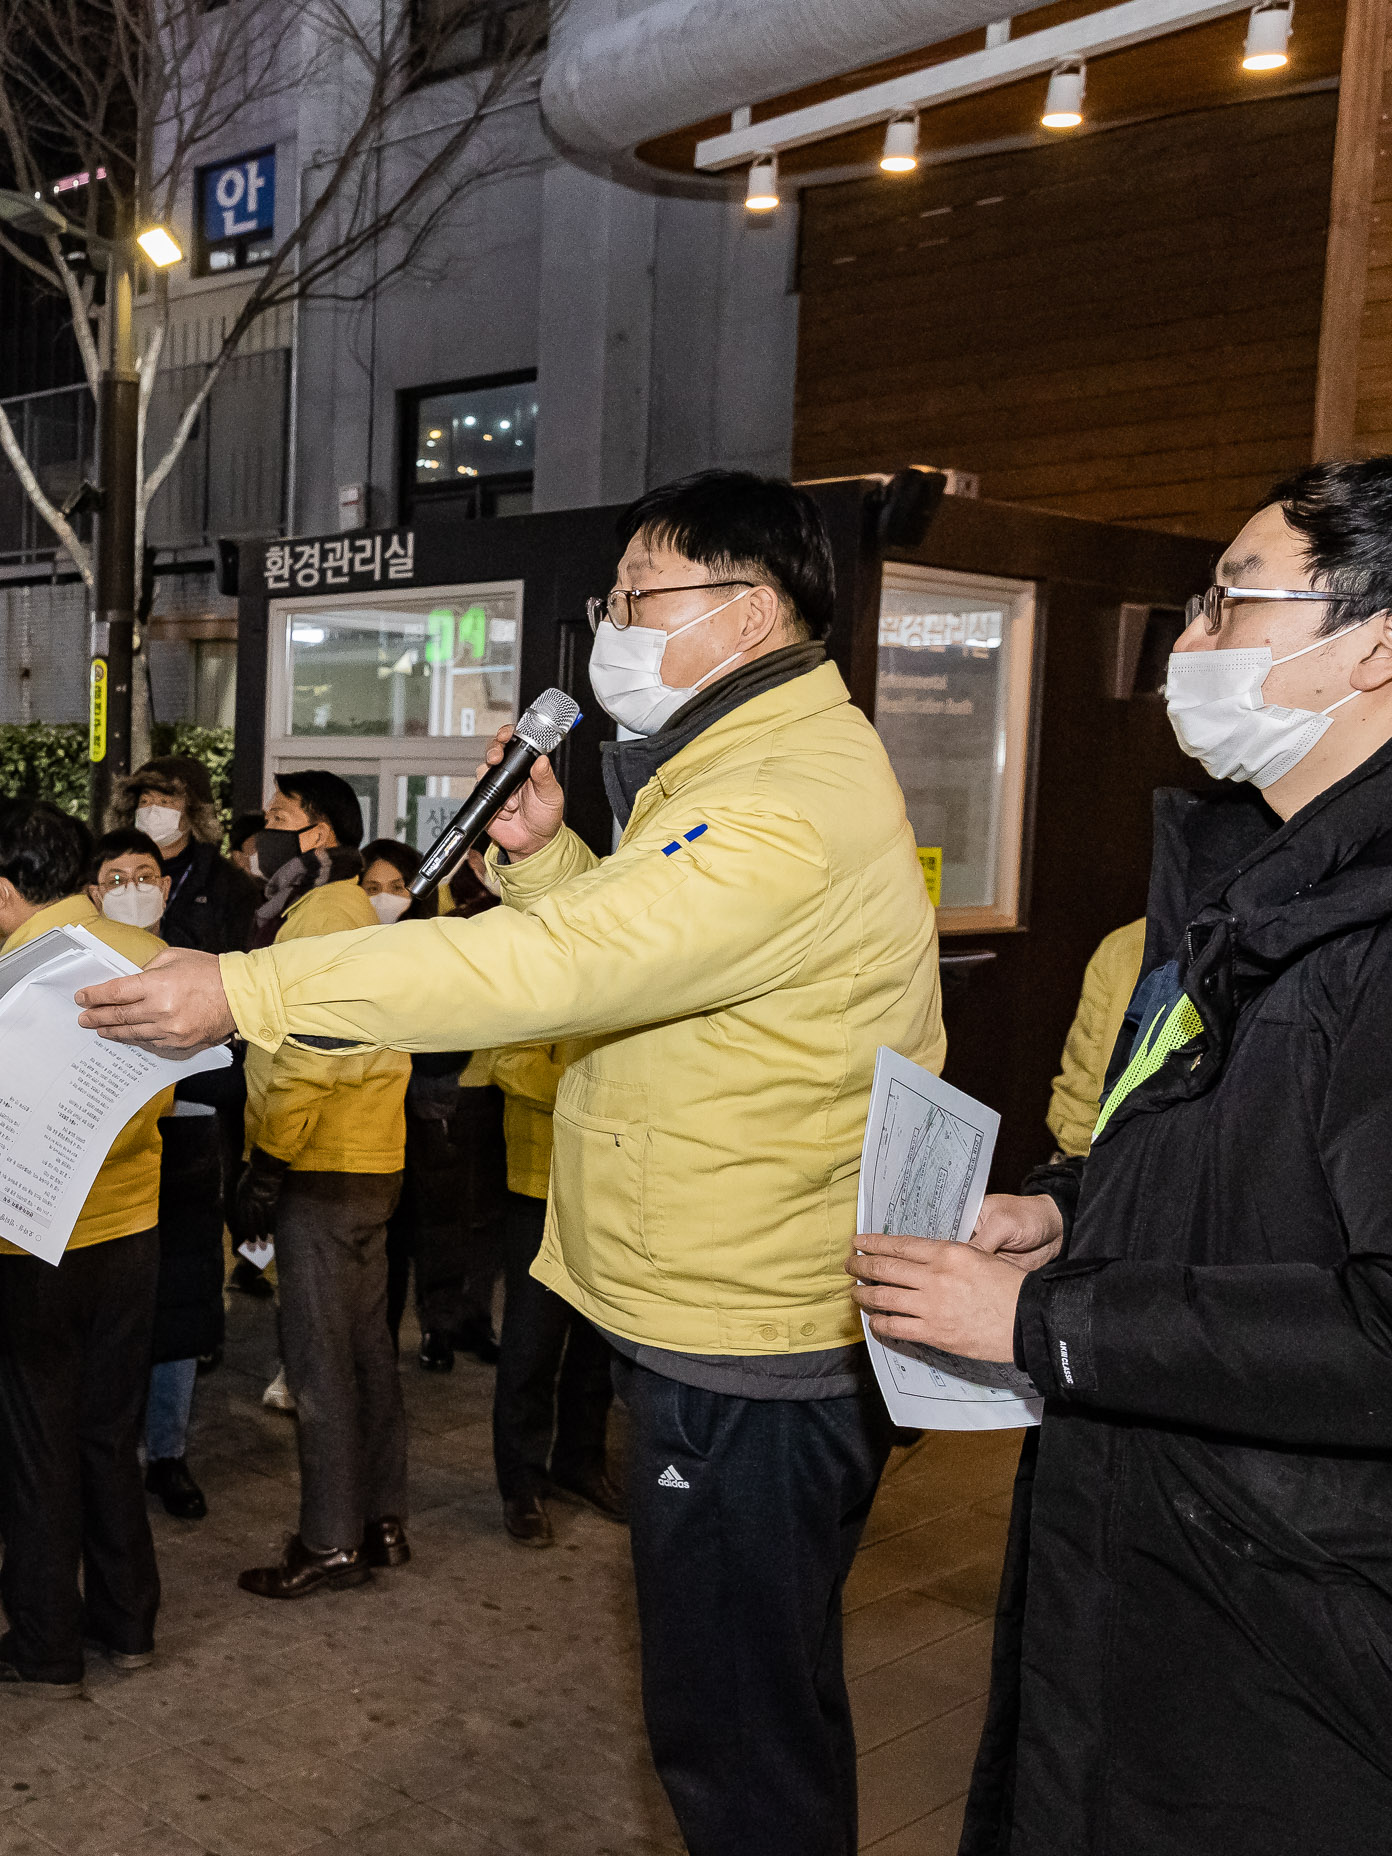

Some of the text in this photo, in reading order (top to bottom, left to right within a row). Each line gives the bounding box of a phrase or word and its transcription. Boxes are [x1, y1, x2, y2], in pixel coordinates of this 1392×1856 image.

[216, 161, 265, 236] 안
[264, 531, 415, 589] 환경관리실
[657, 1478, 690, 1489] adidas
